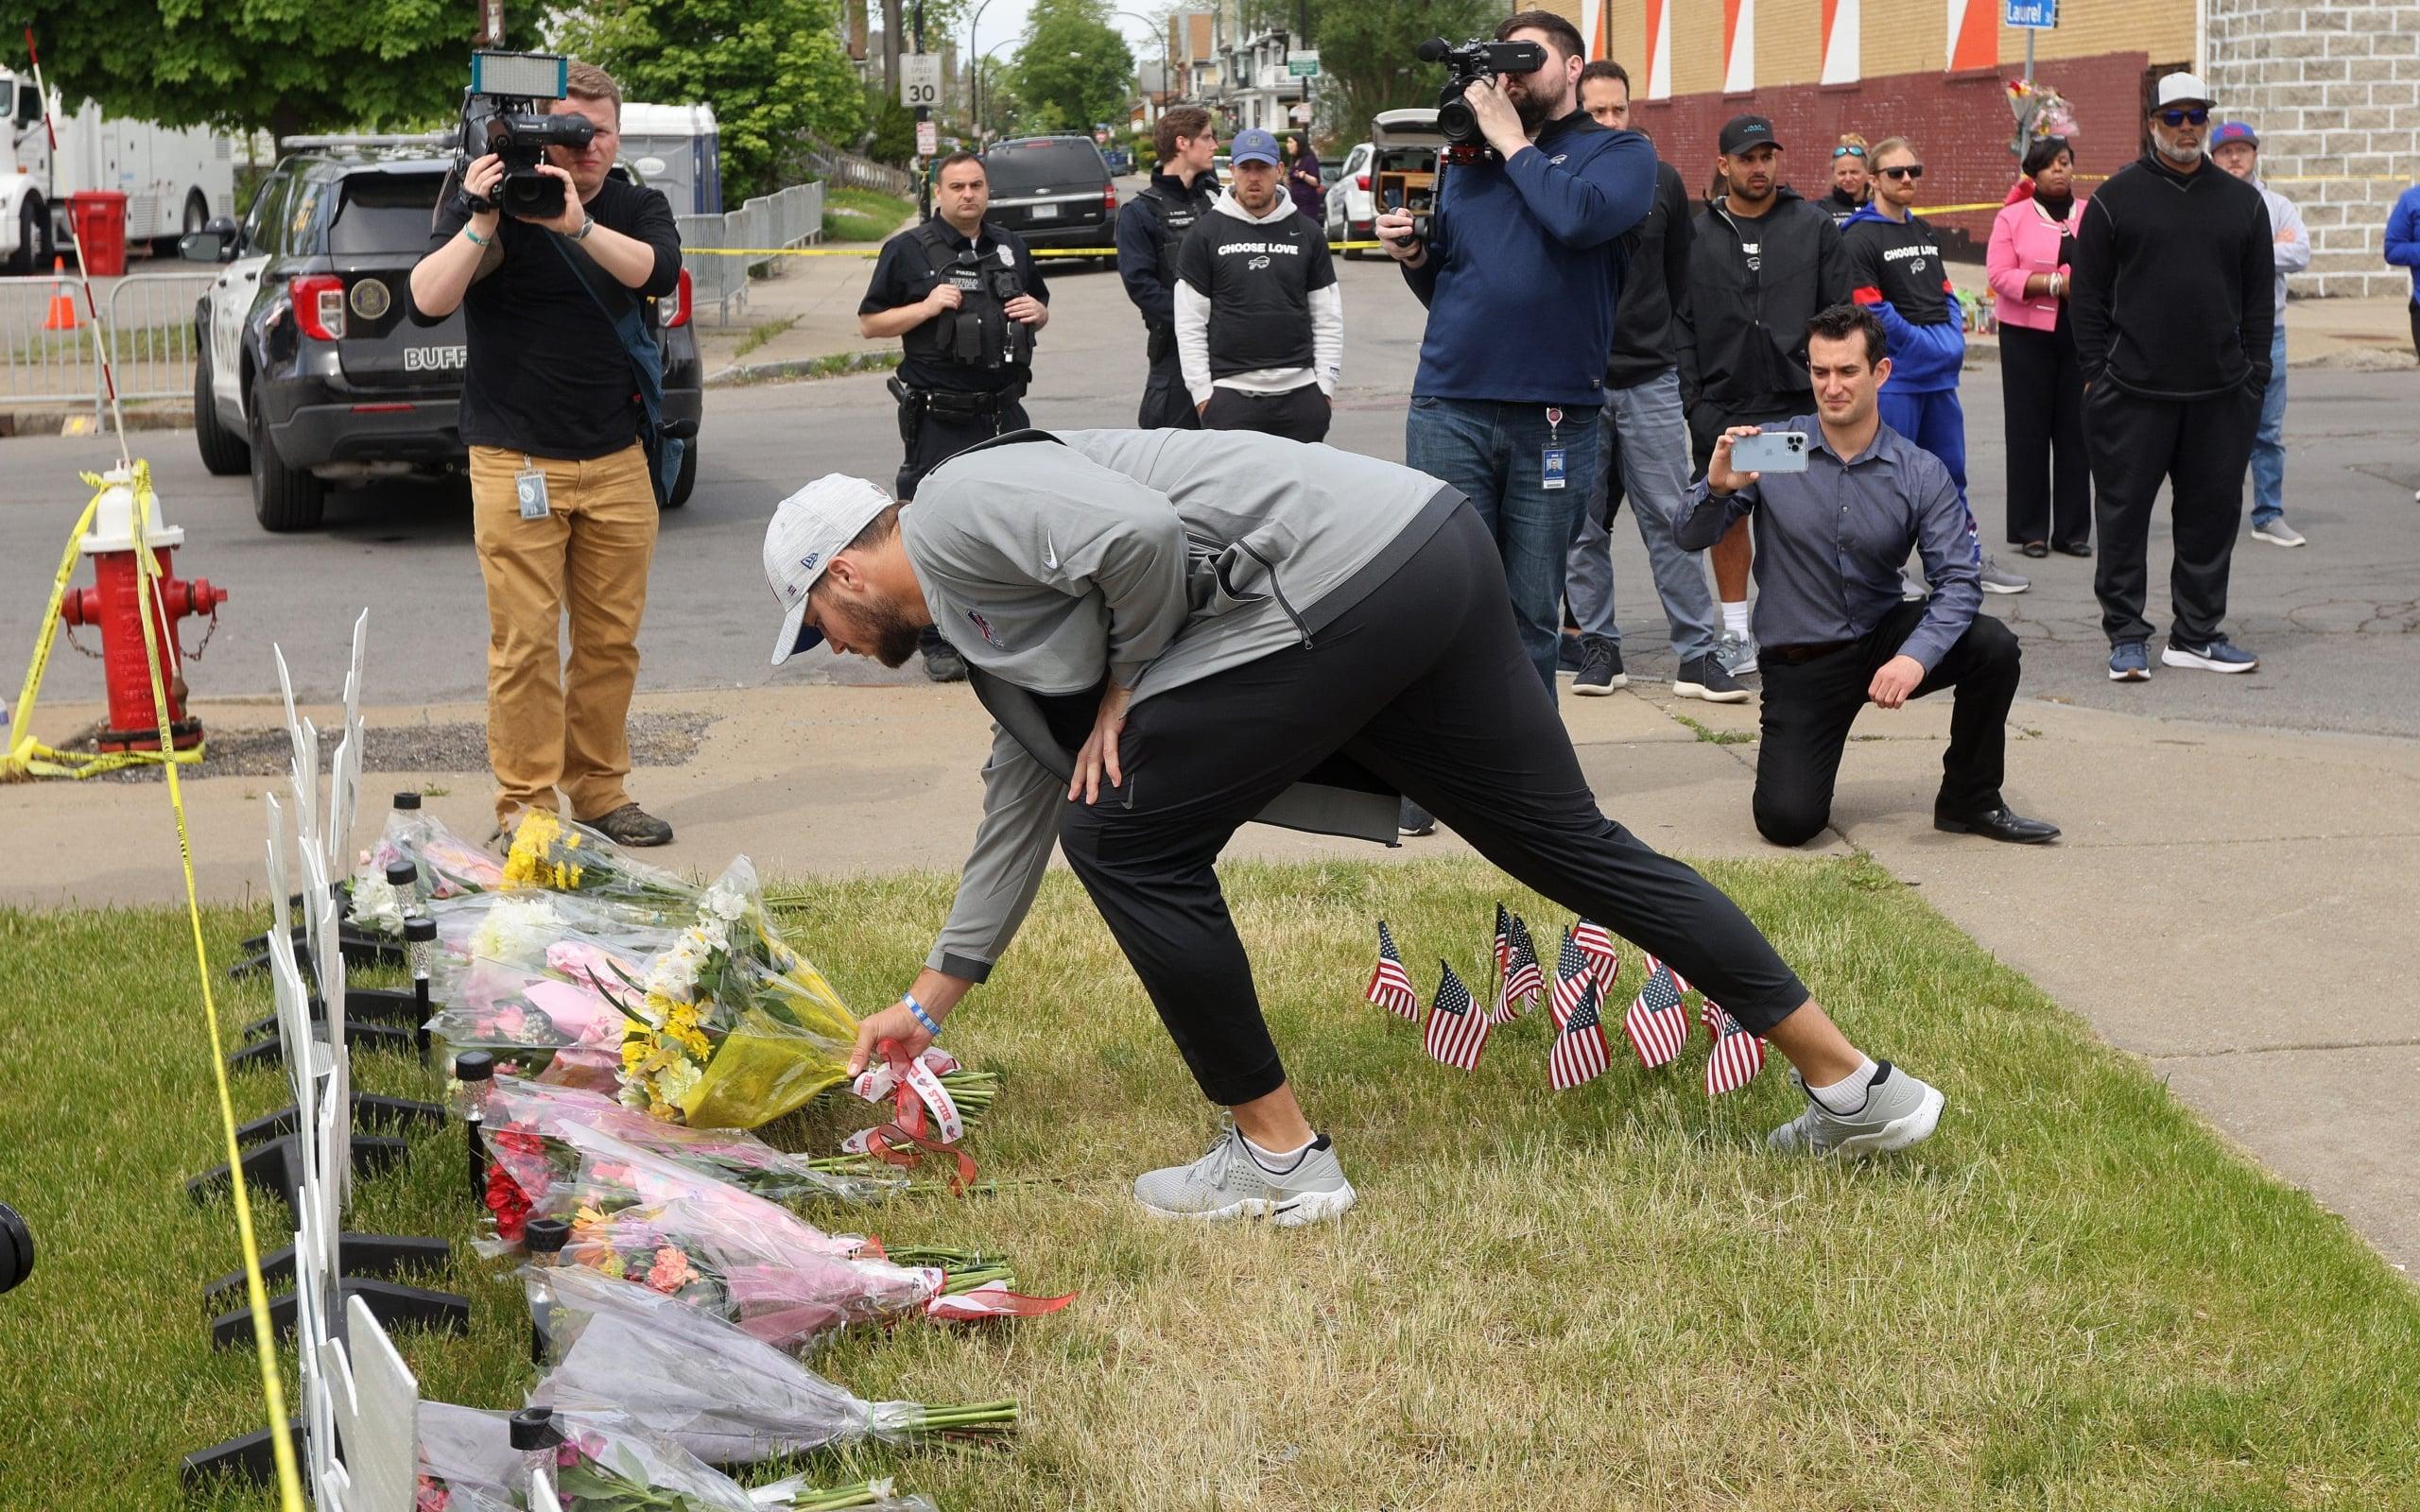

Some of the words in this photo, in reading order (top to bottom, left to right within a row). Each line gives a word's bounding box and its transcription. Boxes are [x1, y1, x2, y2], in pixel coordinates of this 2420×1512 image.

[2007, 1, 2042, 24] Laurel
[908, 84, 935, 102] 30
[1218, 243, 1267, 256] CHOOSE
[1268, 243, 1299, 255] LOVE
[1883, 246, 1920, 262] CHOOSE
[404, 346, 467, 371] BUFF
[928, 1090, 953, 1123] BILLS
